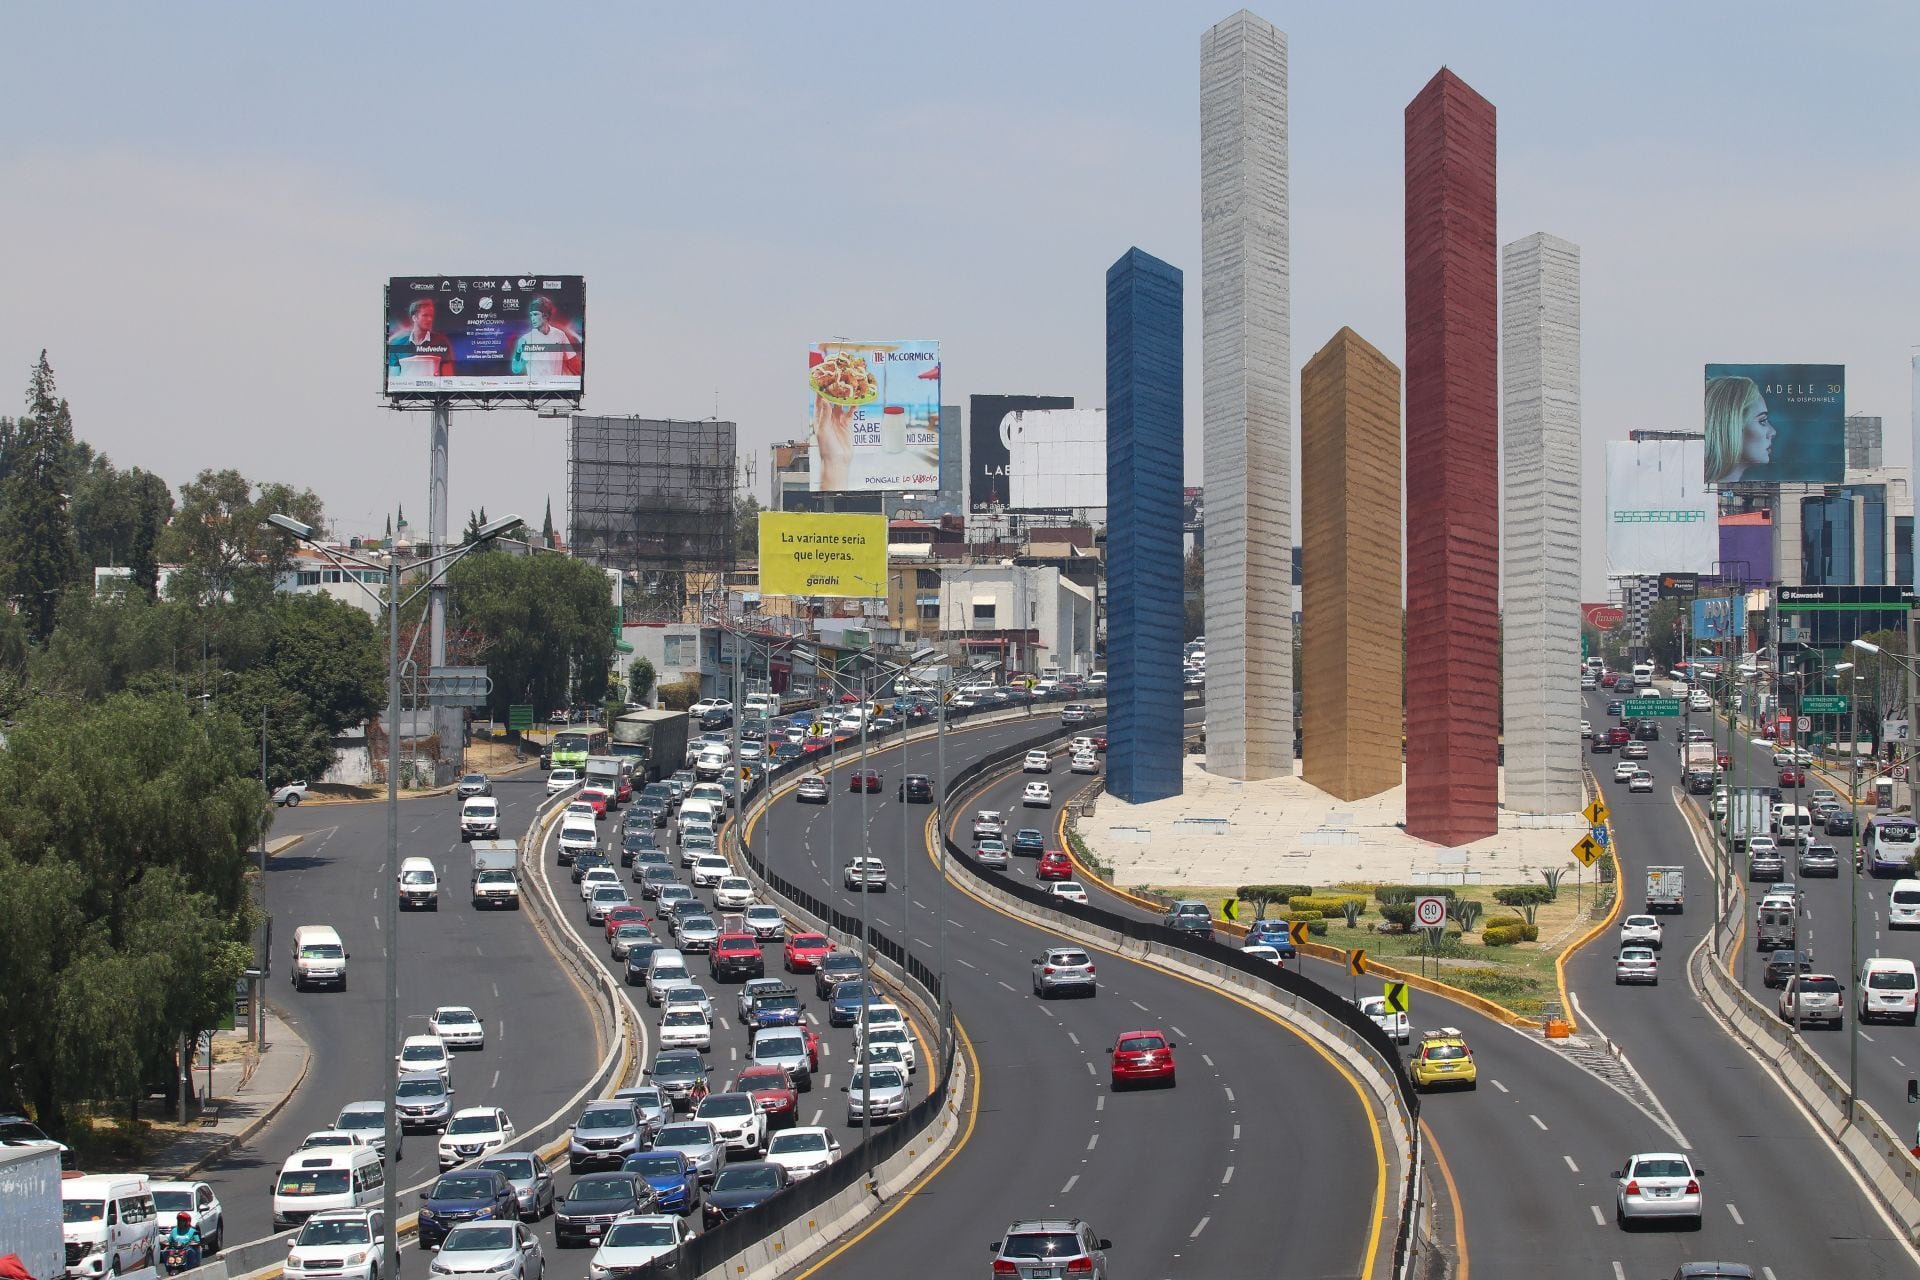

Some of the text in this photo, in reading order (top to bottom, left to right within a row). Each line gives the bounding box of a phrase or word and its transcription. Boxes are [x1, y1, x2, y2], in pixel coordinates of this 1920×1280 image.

[473, 281, 496, 289] CDMX
[416, 345, 448, 353] Medvedev
[888, 352, 934, 361] McCORMICK
[1765, 384, 1841, 394] ADELE 30
[853, 410, 866, 421] SE
[853, 423, 881, 433] SABE
[854, 434, 881, 444] QUE SIN
[906, 434, 935, 443] NO SABE
[781, 532, 794, 543] La
[797, 533, 840, 544] variante
[793, 549, 855, 563] que leyeras.
[806, 576, 840, 586] gandhi
[1424, 904, 1437, 915] 80
